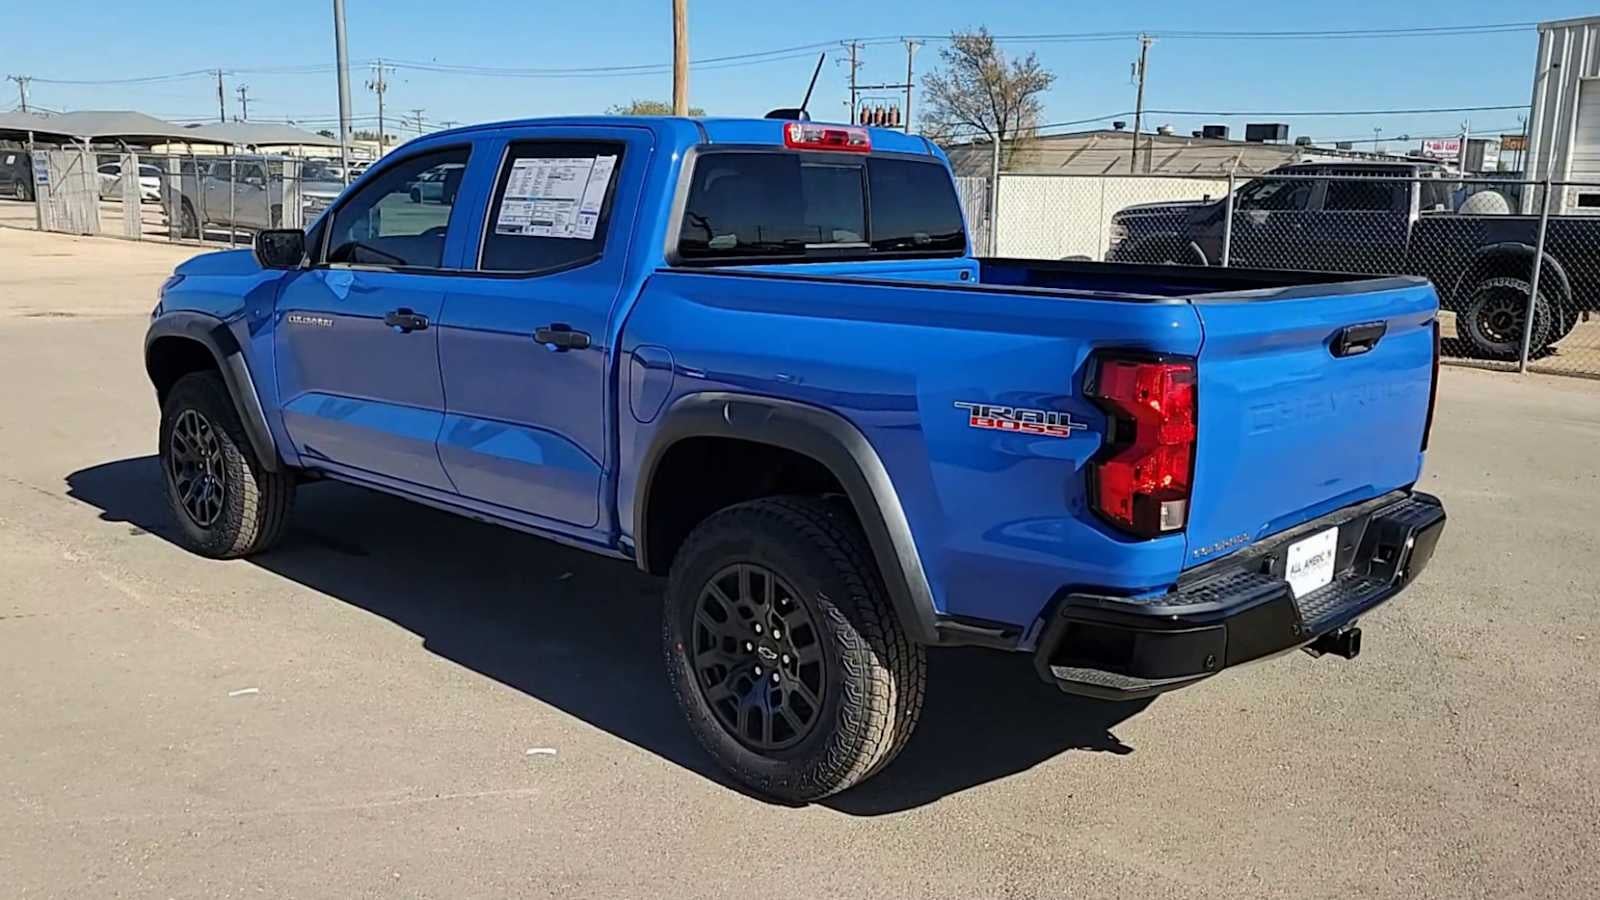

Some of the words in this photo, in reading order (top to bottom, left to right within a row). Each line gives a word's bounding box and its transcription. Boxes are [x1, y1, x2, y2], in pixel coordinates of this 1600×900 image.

[954, 401, 1088, 430] TRAIL
[969, 416, 1071, 438] BOSS
[1290, 560, 1302, 574] ALL
